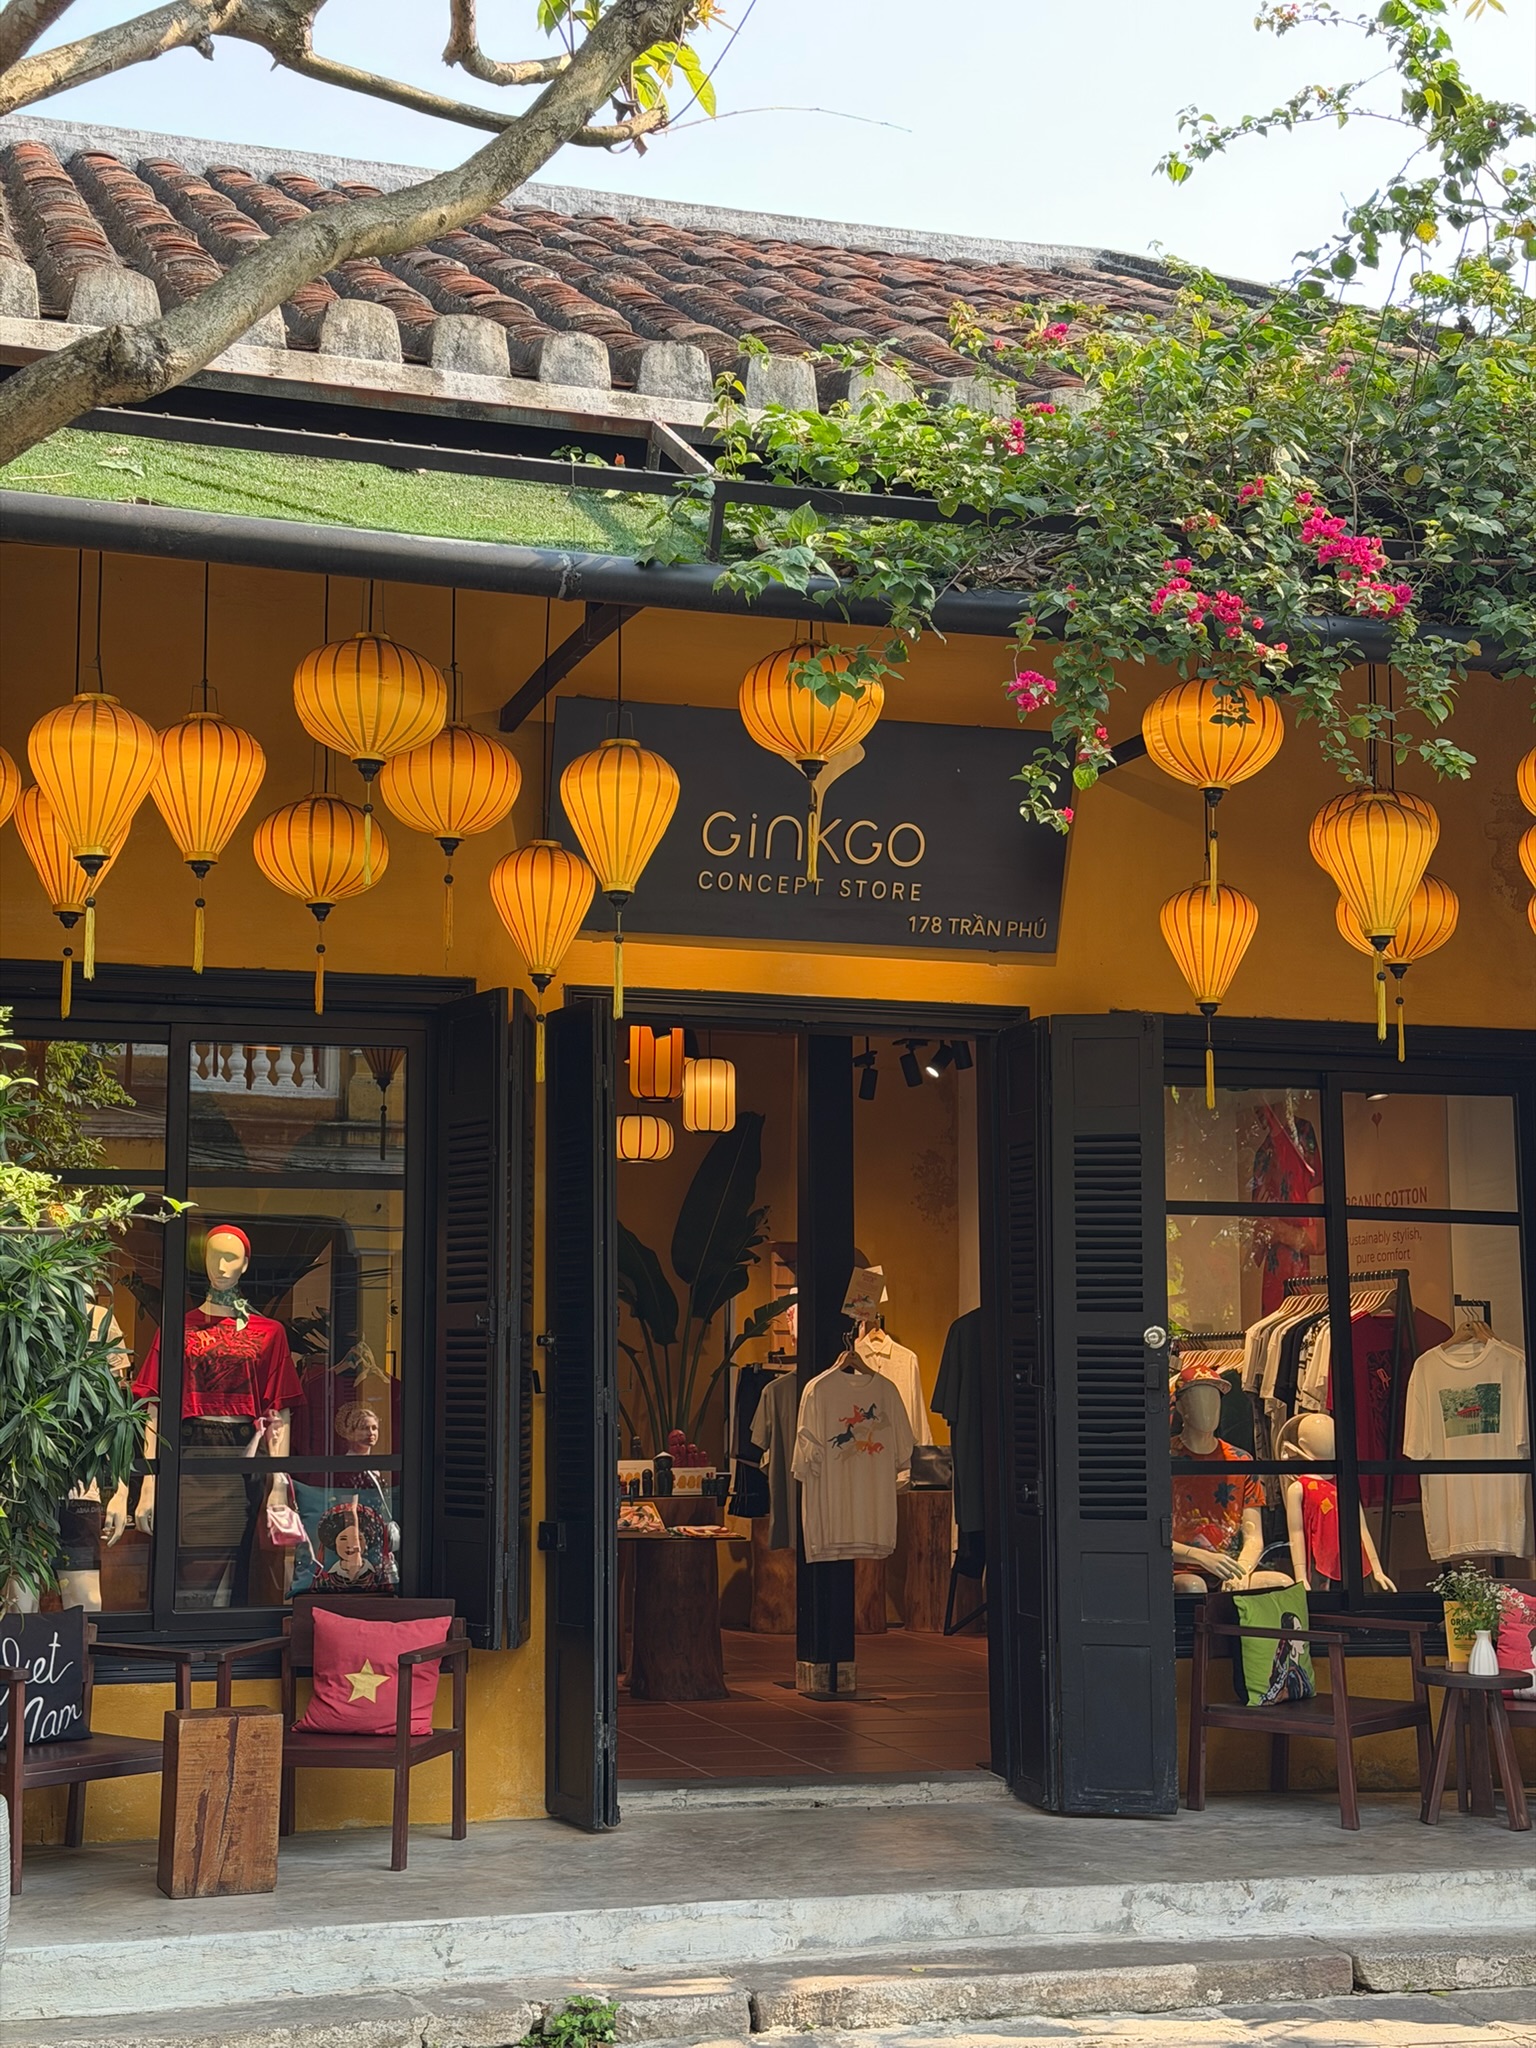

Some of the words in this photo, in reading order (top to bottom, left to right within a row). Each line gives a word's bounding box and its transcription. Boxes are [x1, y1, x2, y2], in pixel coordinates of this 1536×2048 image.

[698, 870, 824, 896] CONCEPT
[839, 879, 922, 902] STORE
[908, 915, 942, 934] 178
[948, 913, 1001, 936] TRẦN
[1007, 918, 1047, 939] PHÚ
[1385, 1186, 1428, 1207] COTTON
[1349, 1230, 1391, 1246] ustainably
[1392, 1227, 1422, 1244] stylish,
[1356, 1253, 1375, 1267] pure
[1376, 1248, 1411, 1262] comfort
